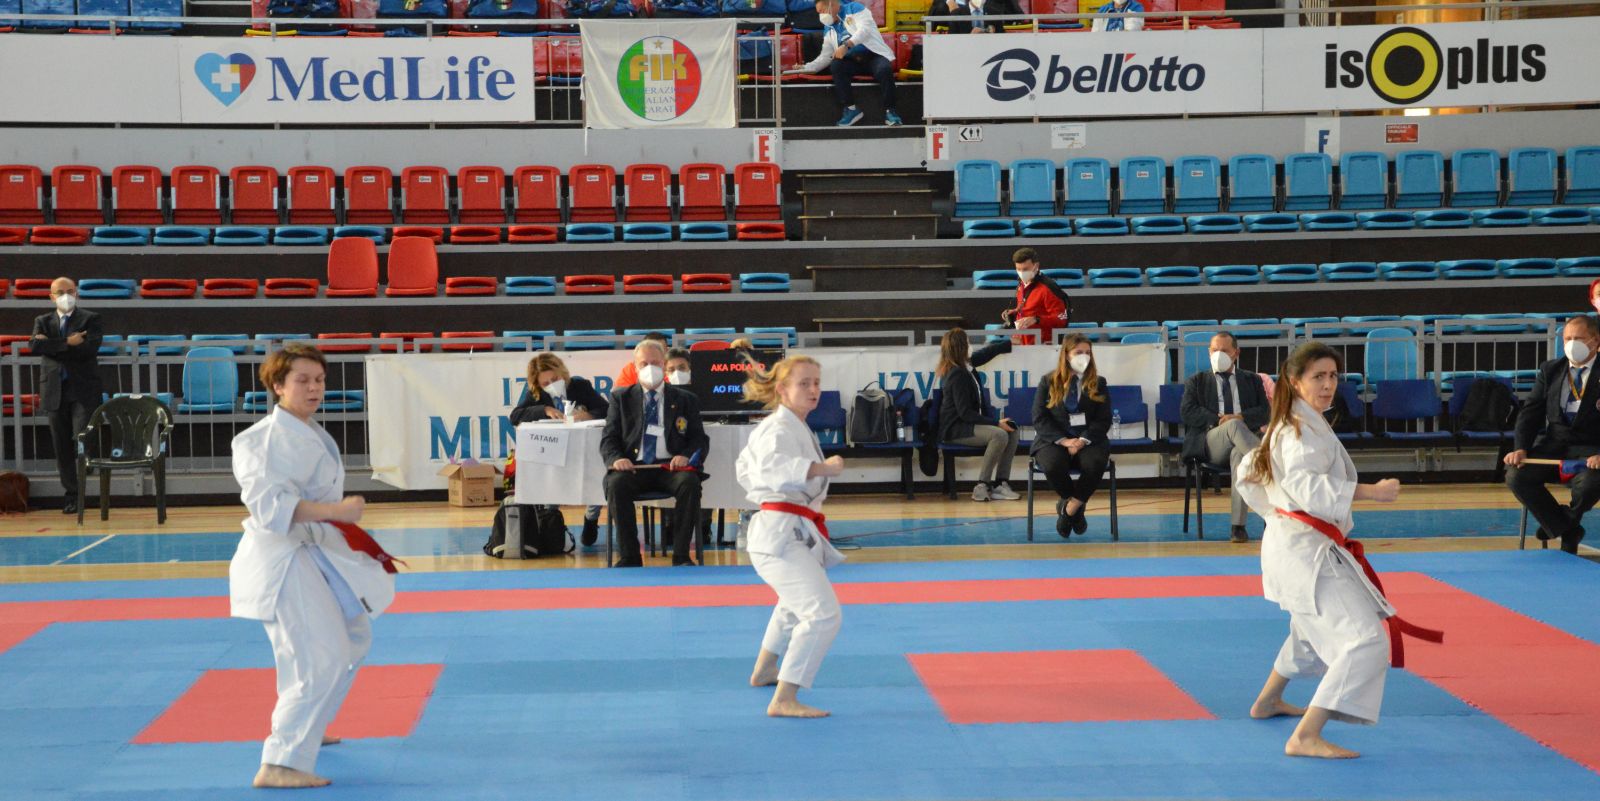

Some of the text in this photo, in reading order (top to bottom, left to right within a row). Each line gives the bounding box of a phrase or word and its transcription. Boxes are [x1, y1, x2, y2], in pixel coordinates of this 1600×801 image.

[265, 55, 516, 101] MedLife
[629, 53, 688, 81] FIK
[758, 135, 770, 162] E
[932, 132, 944, 160] F
[1318, 129, 1330, 153] F
[711, 363, 766, 372] AKA POLAD
[713, 385, 727, 394] AO
[727, 385, 741, 393] FIK
[529, 433, 559, 443] TATAMI
